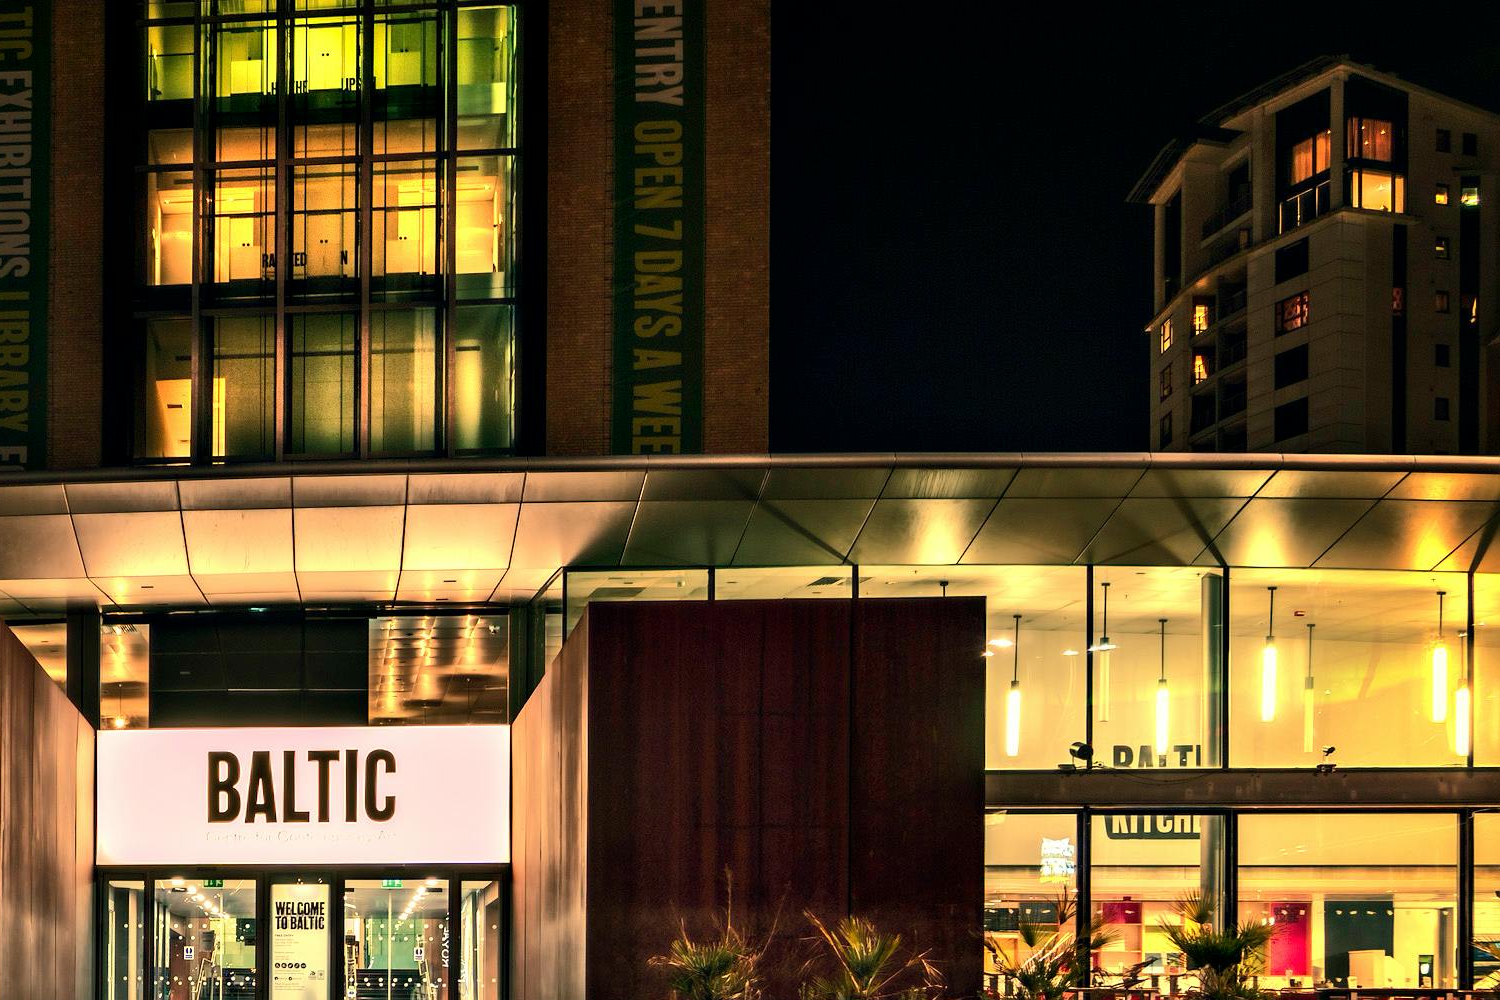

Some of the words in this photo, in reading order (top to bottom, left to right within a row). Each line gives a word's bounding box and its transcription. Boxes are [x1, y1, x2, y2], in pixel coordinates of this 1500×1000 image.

[633, 0, 684, 107] ENTRY
[634, 119, 684, 210] OPEN
[634, 219, 683, 241] 7
[633, 250, 684, 339] DAYS
[632, 348, 682, 371] A
[207, 749, 397, 824] BALTIC
[275, 901, 325, 916] WELCOME
[275, 916, 288, 930] TO
[290, 916, 325, 930] BALTIC
